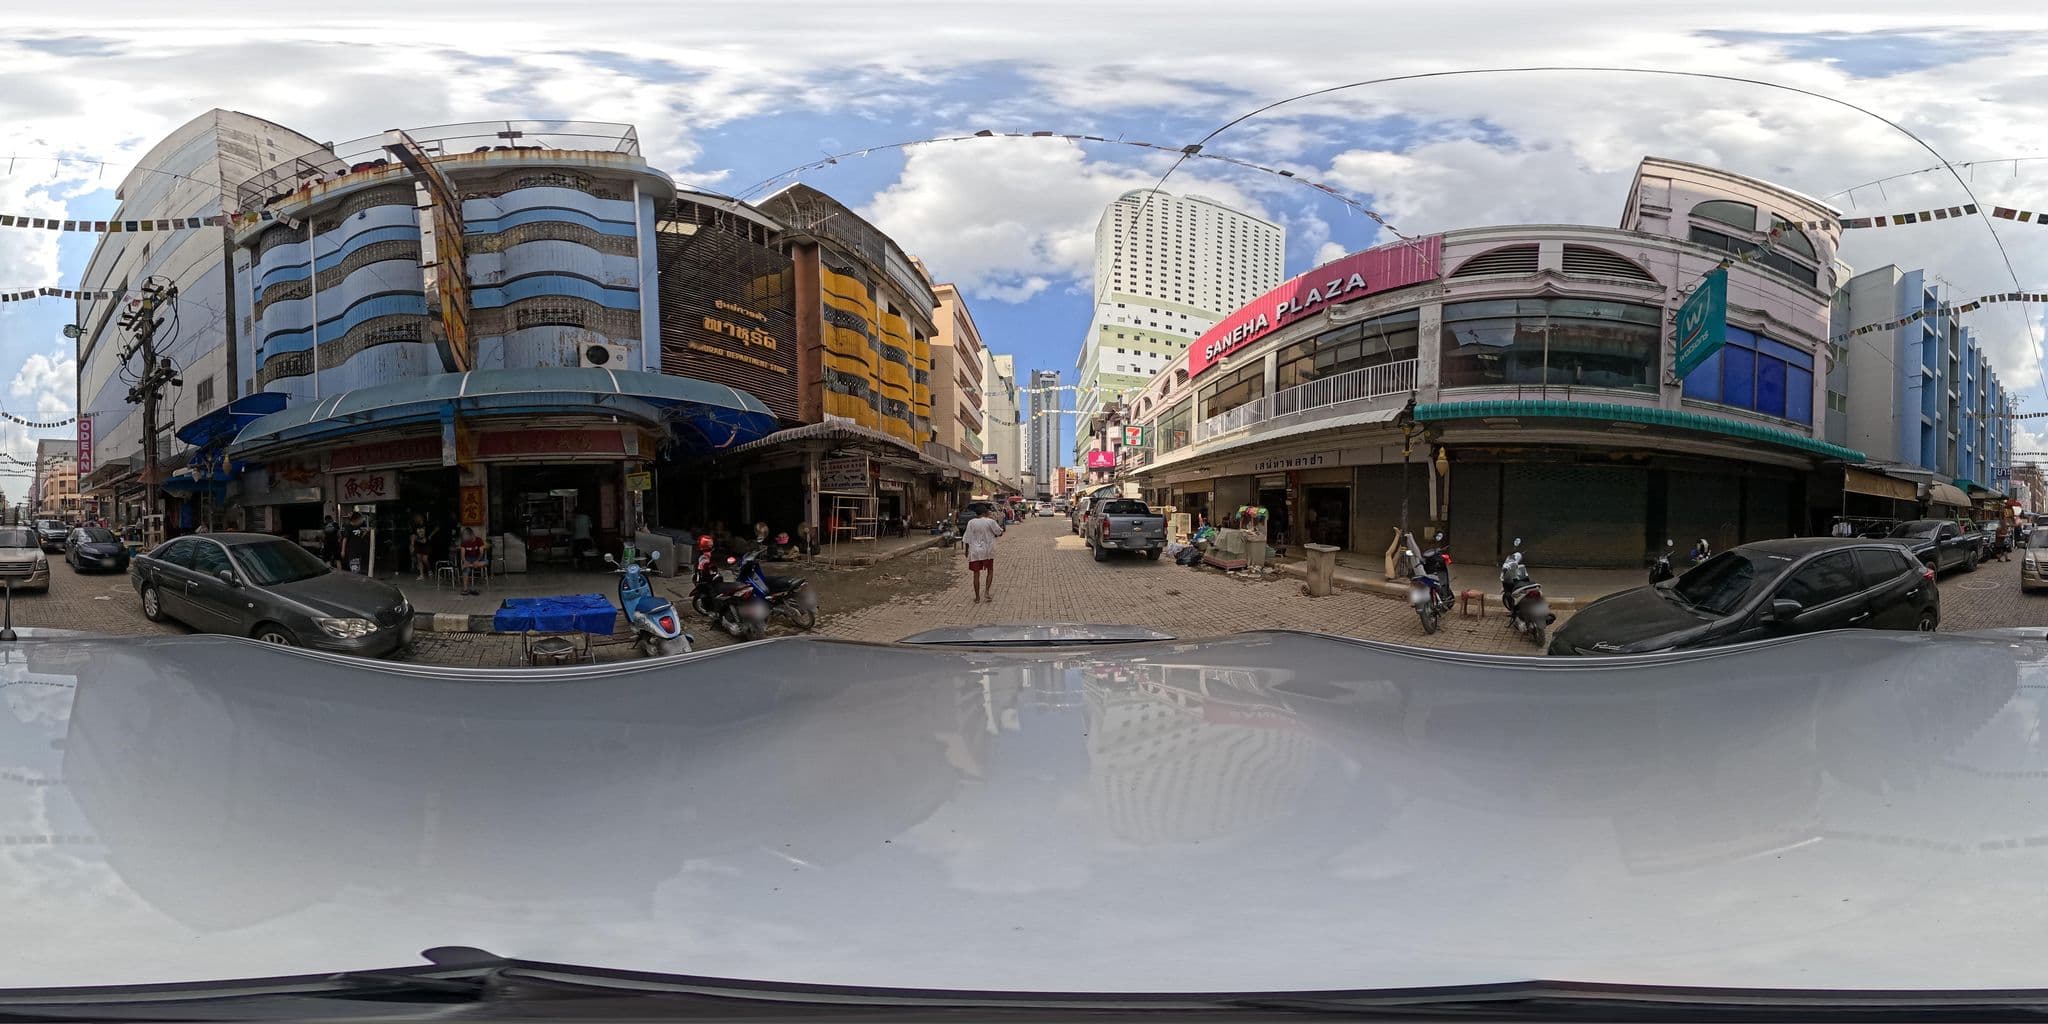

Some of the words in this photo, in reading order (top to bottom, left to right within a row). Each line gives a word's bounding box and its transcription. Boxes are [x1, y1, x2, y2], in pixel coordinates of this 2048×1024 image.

[703, 316, 777, 351] พาหุรัด
[1205, 313, 1269, 361] SANEHA
[1276, 272, 1367, 322] PLAZA
[1686, 303, 1703, 331] W
[726, 349, 769, 370] DEPARTMENT
[81, 422, 90, 471] ODEAN
